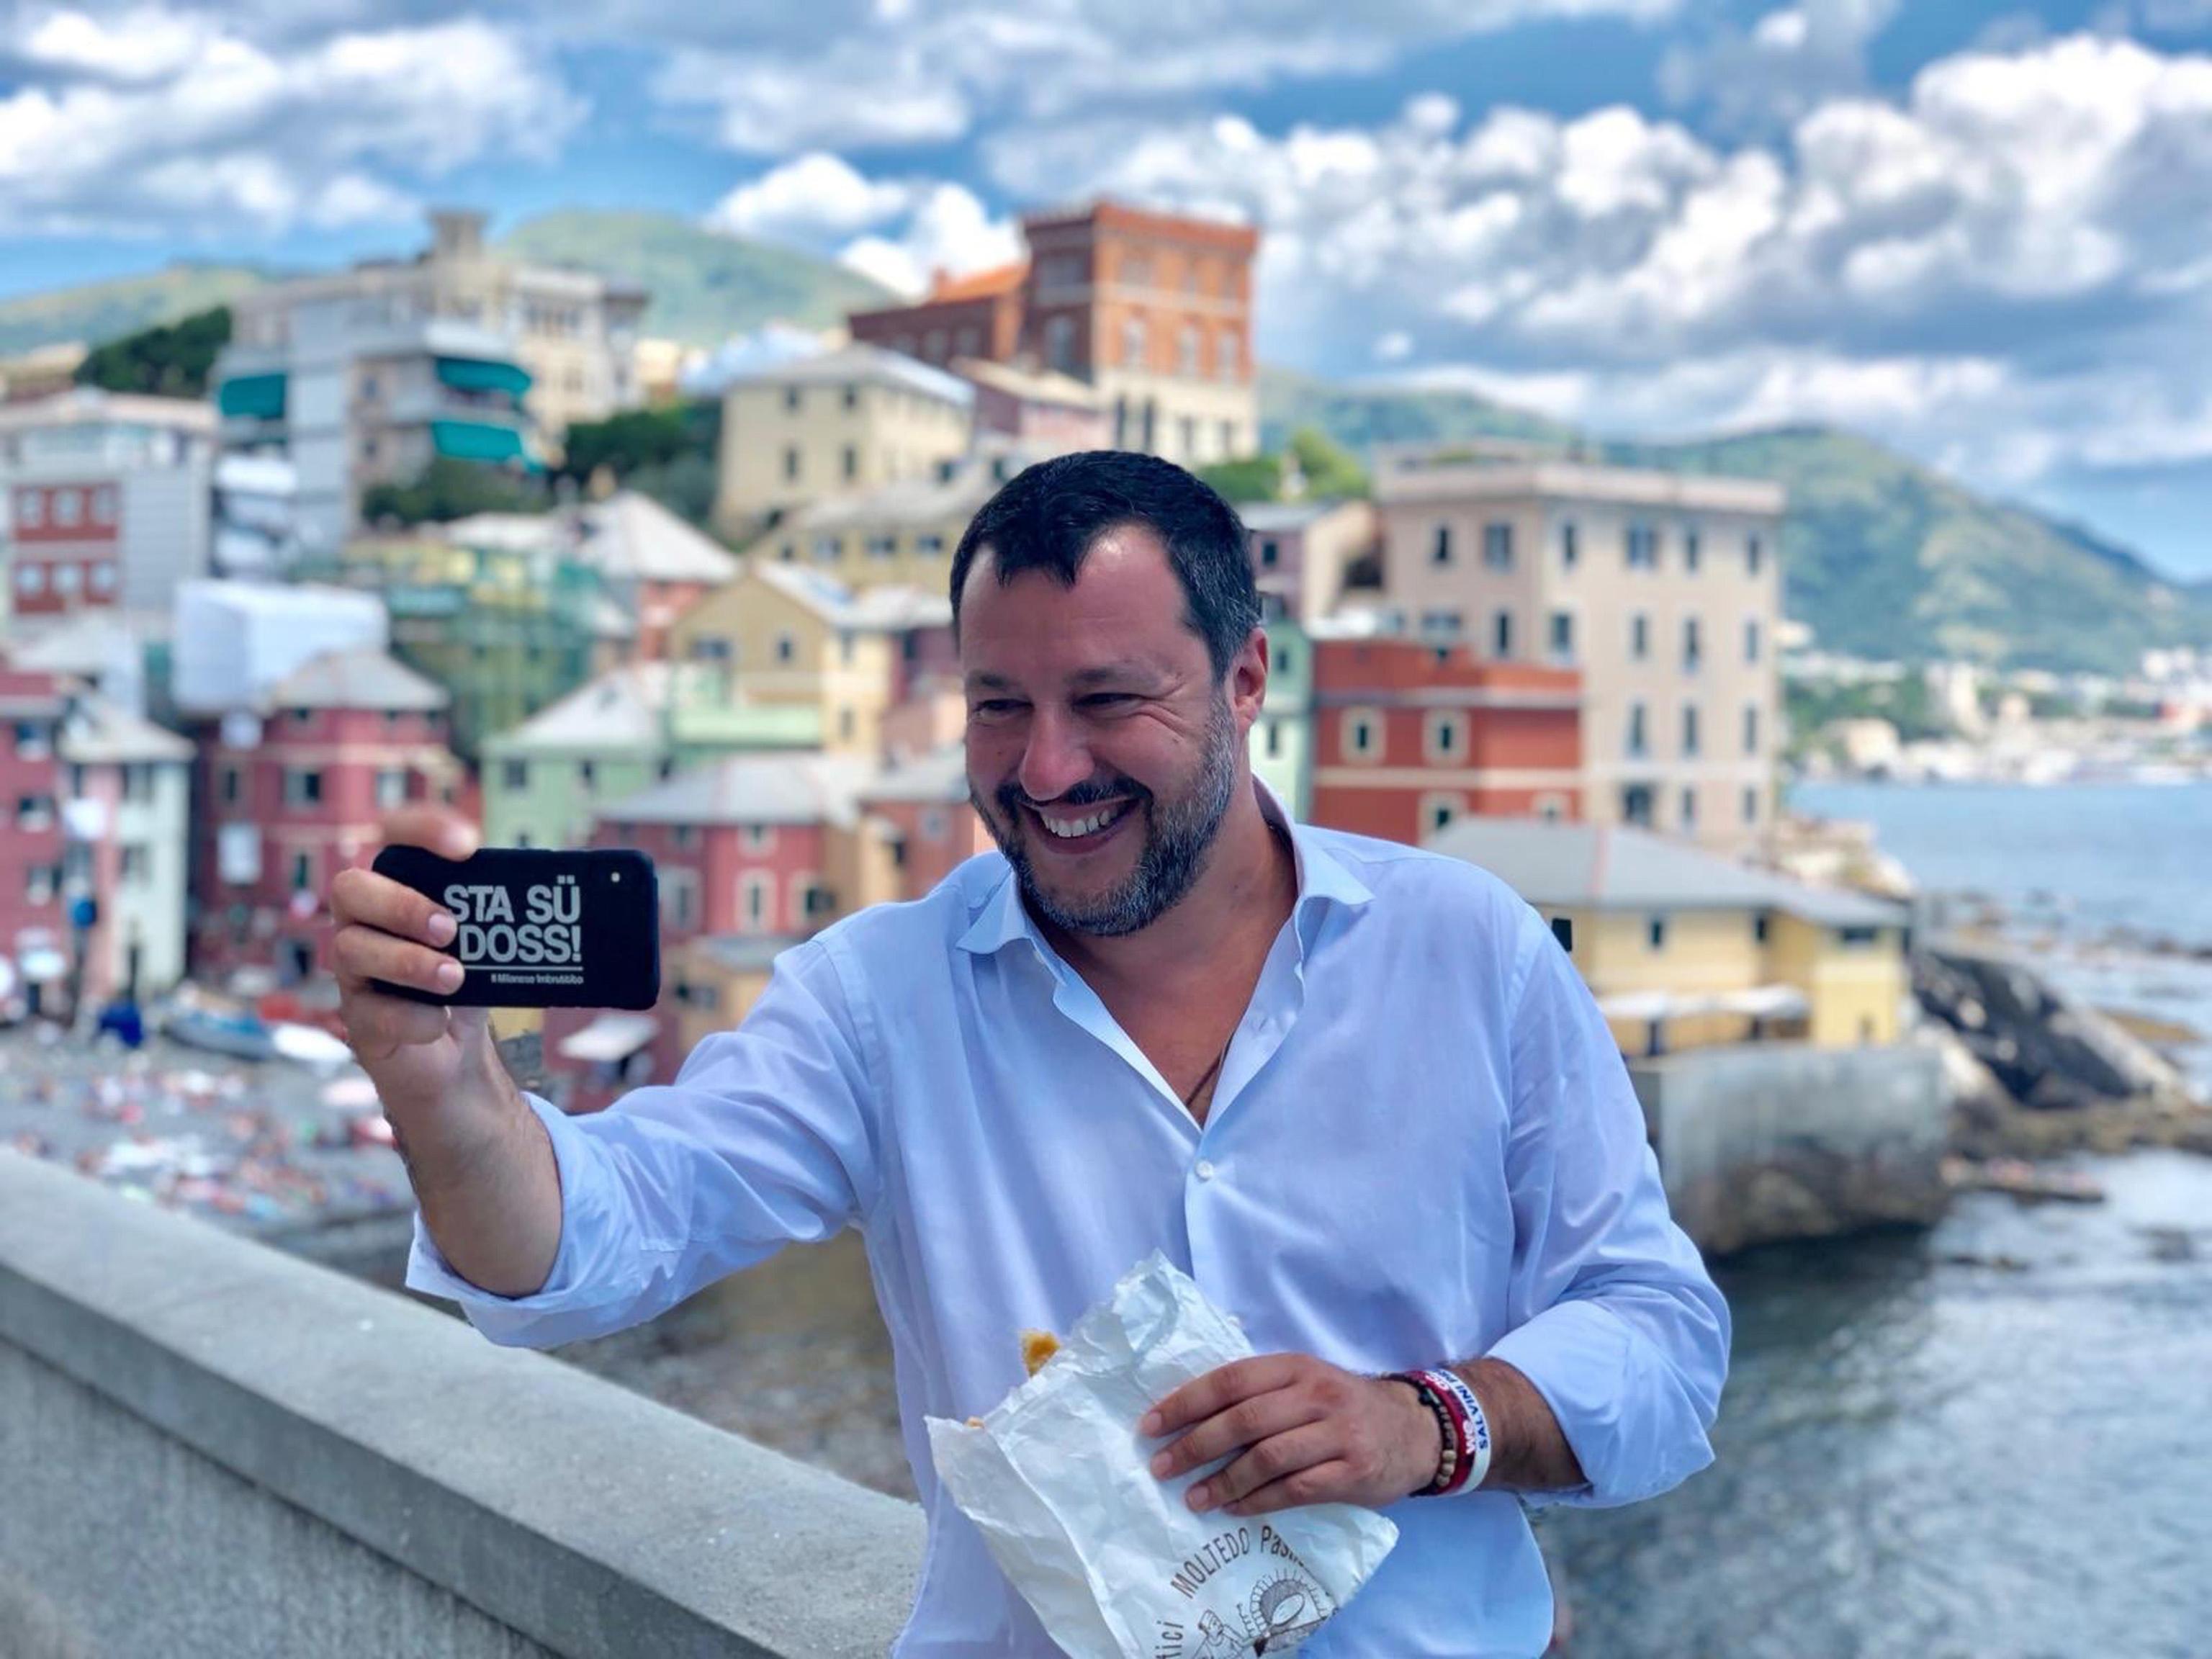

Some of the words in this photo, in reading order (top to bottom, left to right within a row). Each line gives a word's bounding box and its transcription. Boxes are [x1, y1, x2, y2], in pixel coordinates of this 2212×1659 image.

[444, 885, 516, 923] STA
[526, 875, 581, 925] SÜ
[459, 925, 582, 963] DOSS!
[1455, 1385, 1489, 1449] SALVINI
[1171, 1527, 1250, 1599] MOLTEDO
